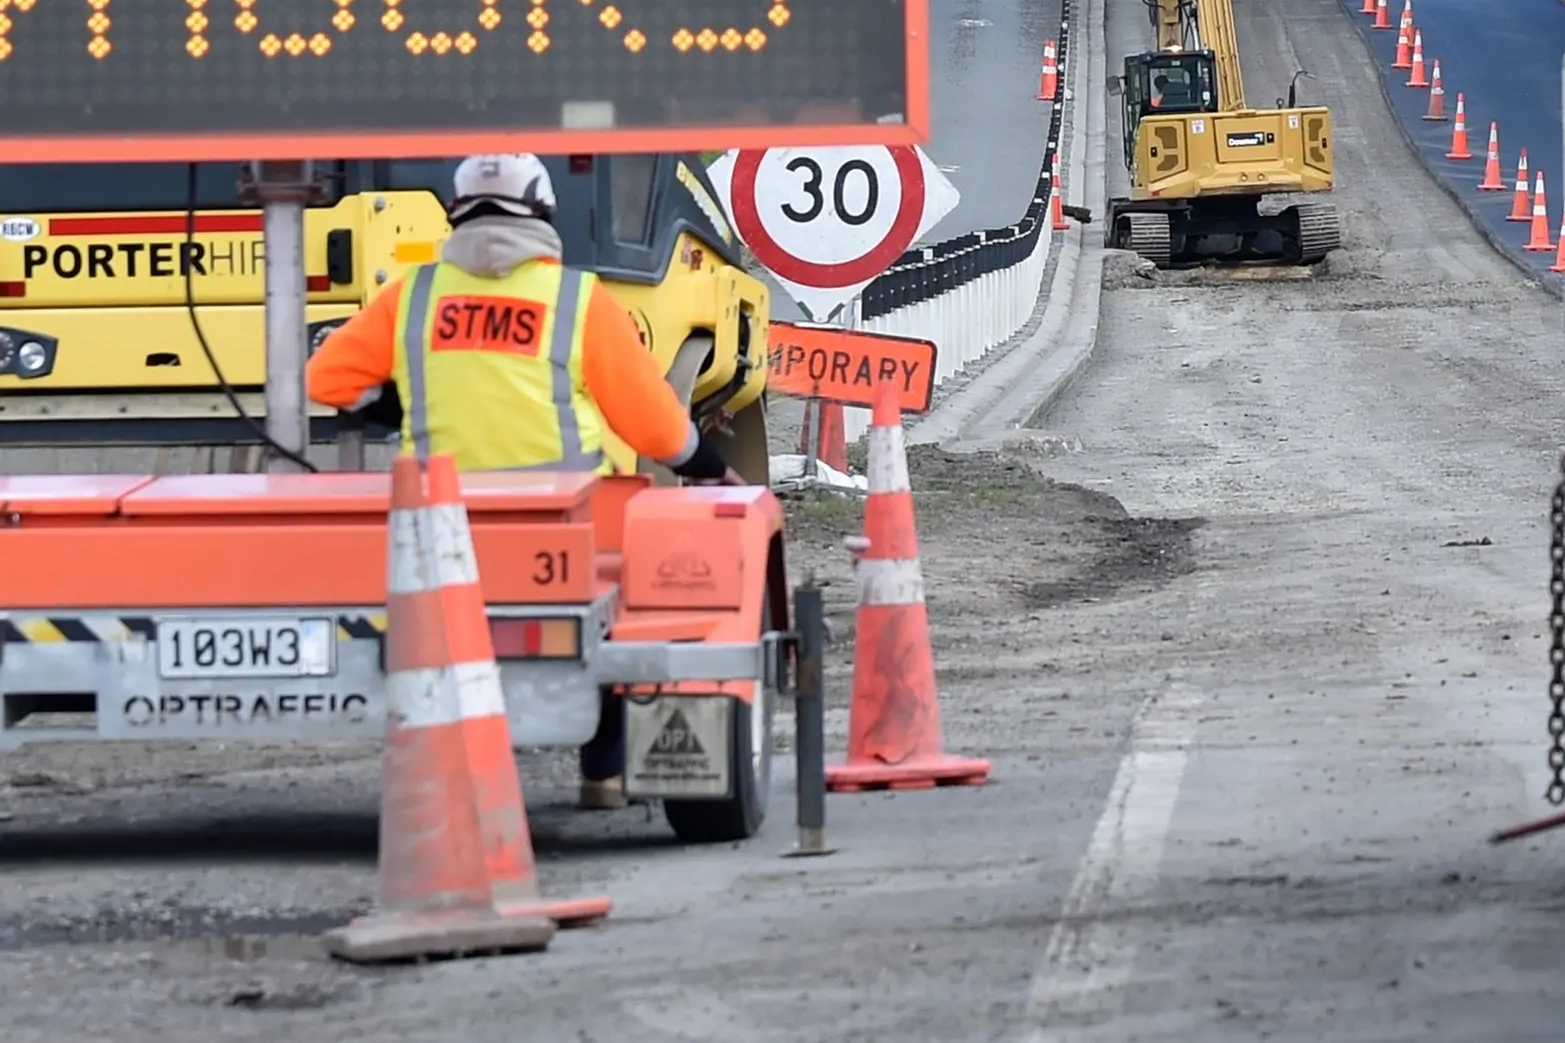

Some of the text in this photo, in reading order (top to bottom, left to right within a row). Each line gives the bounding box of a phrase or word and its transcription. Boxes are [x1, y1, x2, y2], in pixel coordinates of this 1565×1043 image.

[780, 157, 879, 225] 30
[437, 302, 537, 345] STMS
[532, 550, 569, 586] 31
[124, 694, 368, 726] OPTRAFFIC
